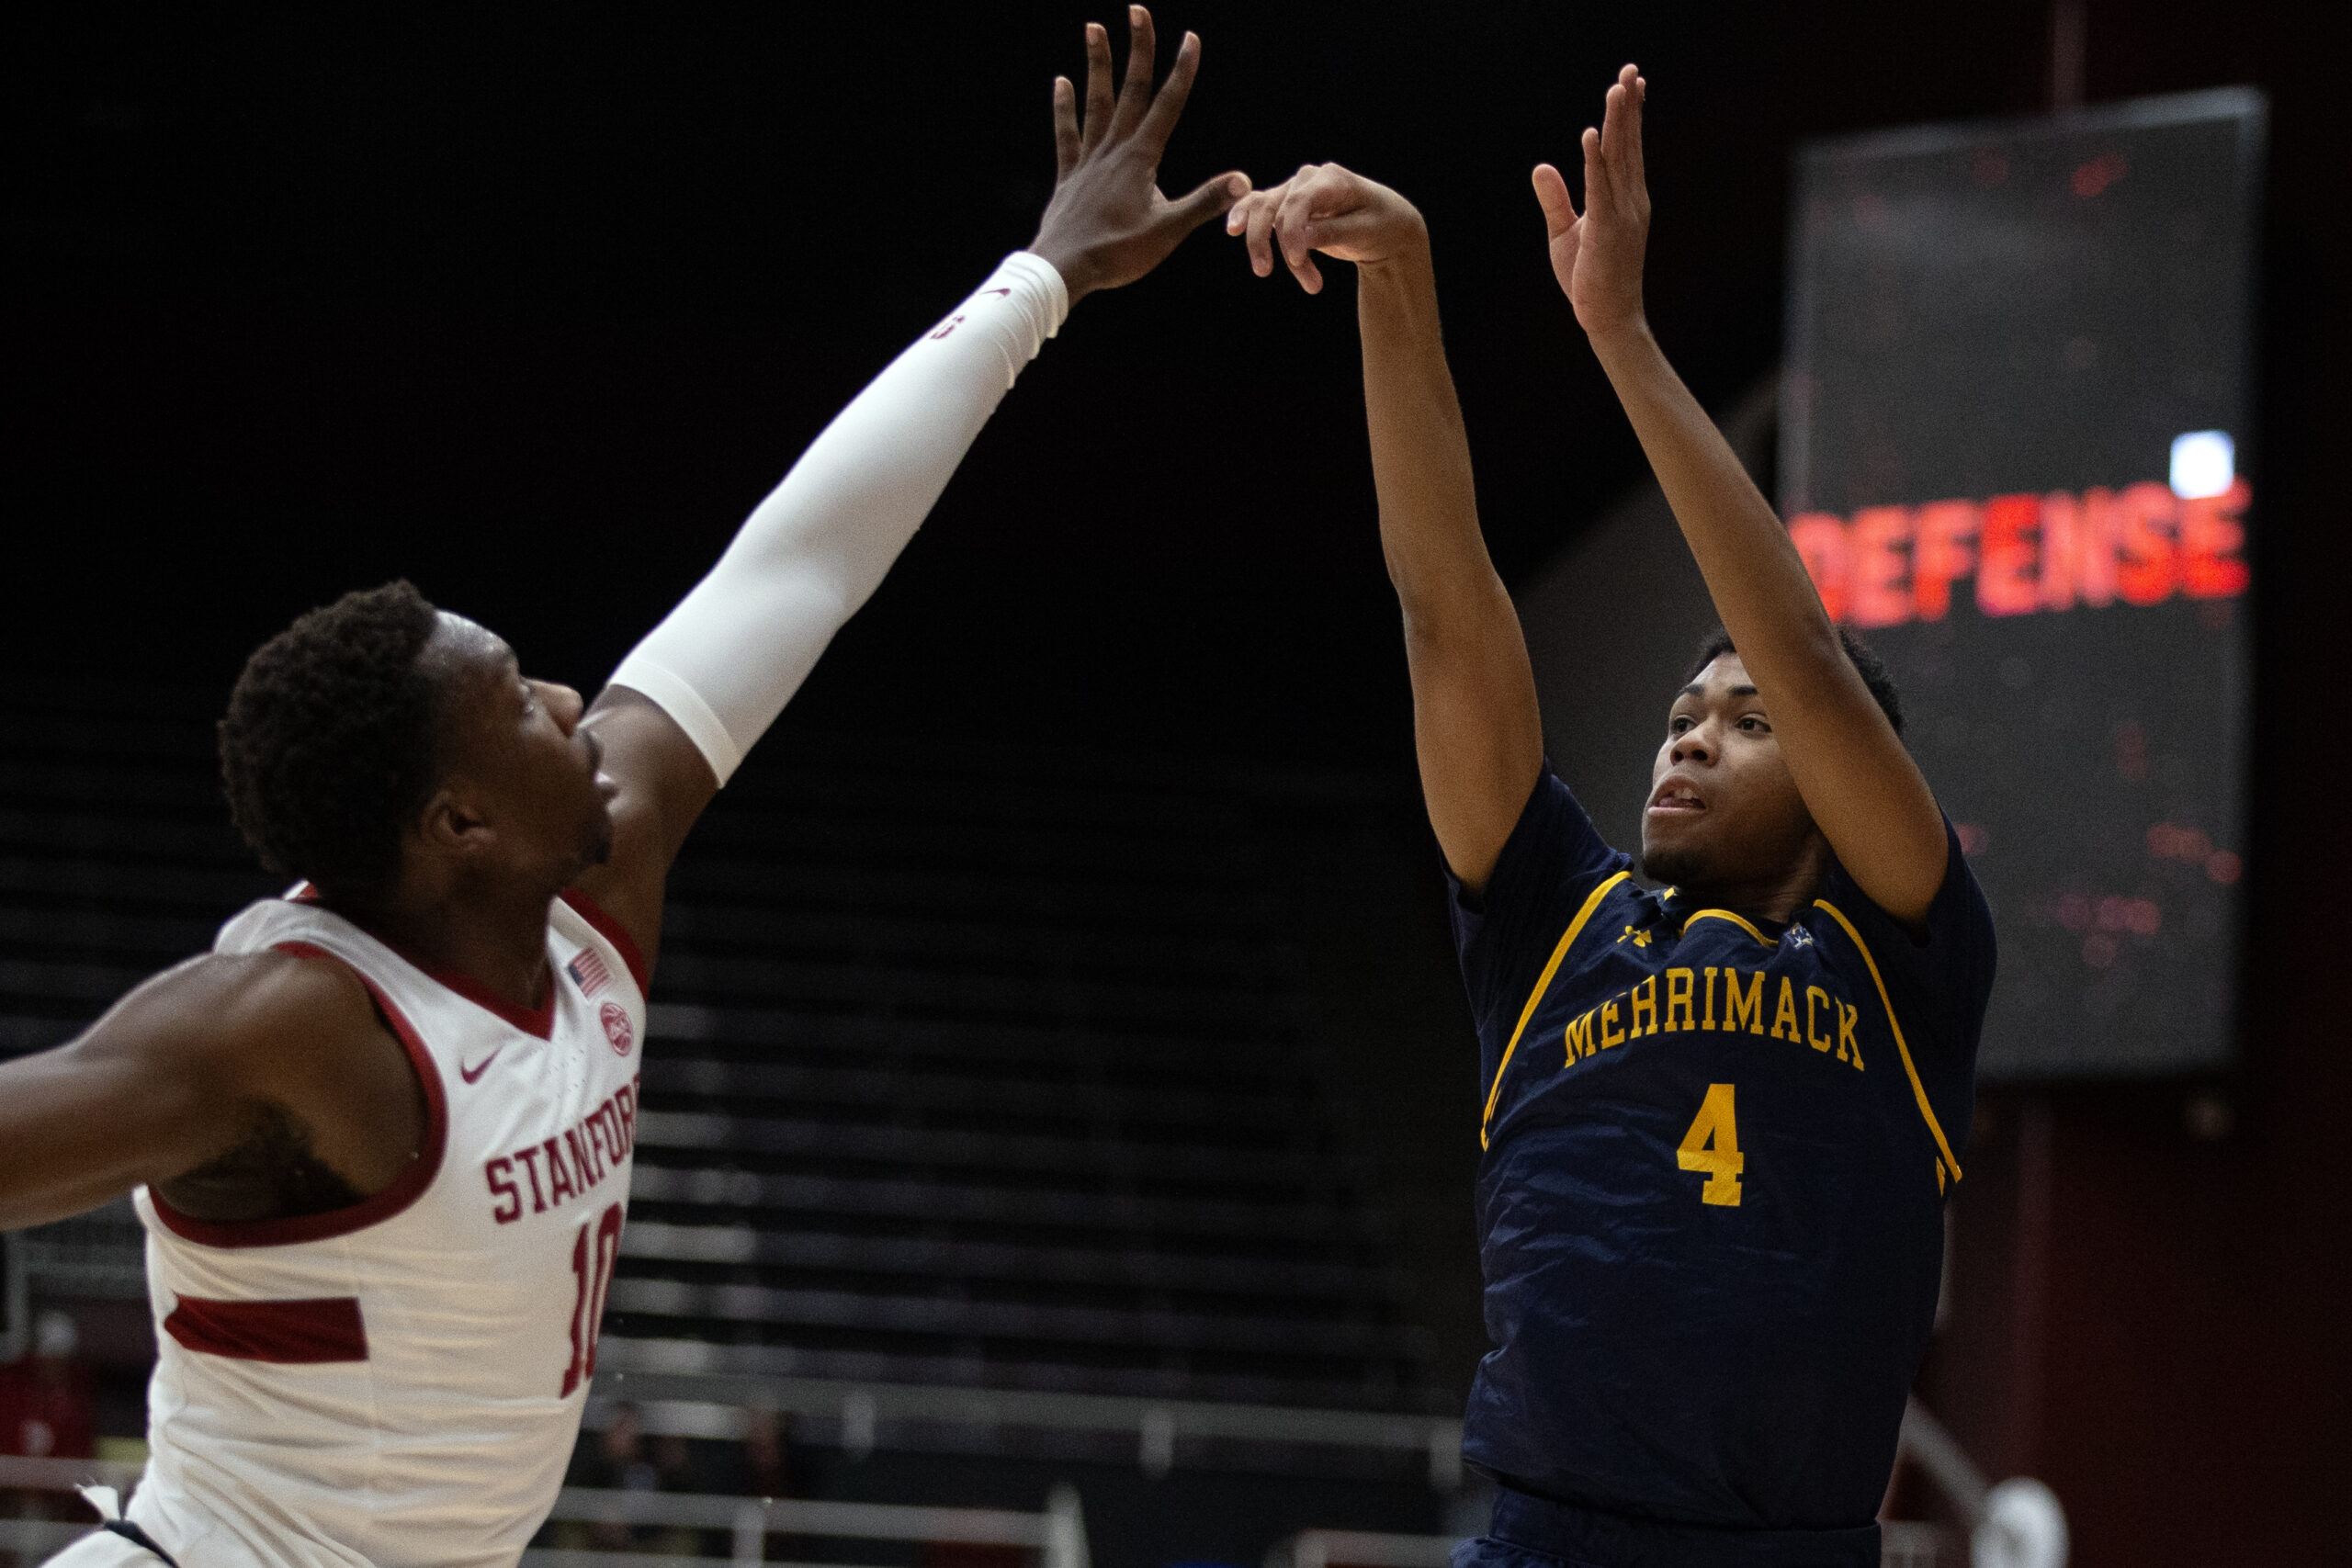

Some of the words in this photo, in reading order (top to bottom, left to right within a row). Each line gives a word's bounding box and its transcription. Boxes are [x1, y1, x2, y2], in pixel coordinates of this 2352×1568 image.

[1789, 475, 2252, 628] DEFENSE
[1565, 967, 1865, 1071] MERRIMACK
[486, 1073, 640, 1224] STANFOR
[1677, 1084, 1744, 1206] 4
[560, 1201, 622, 1399] 10
